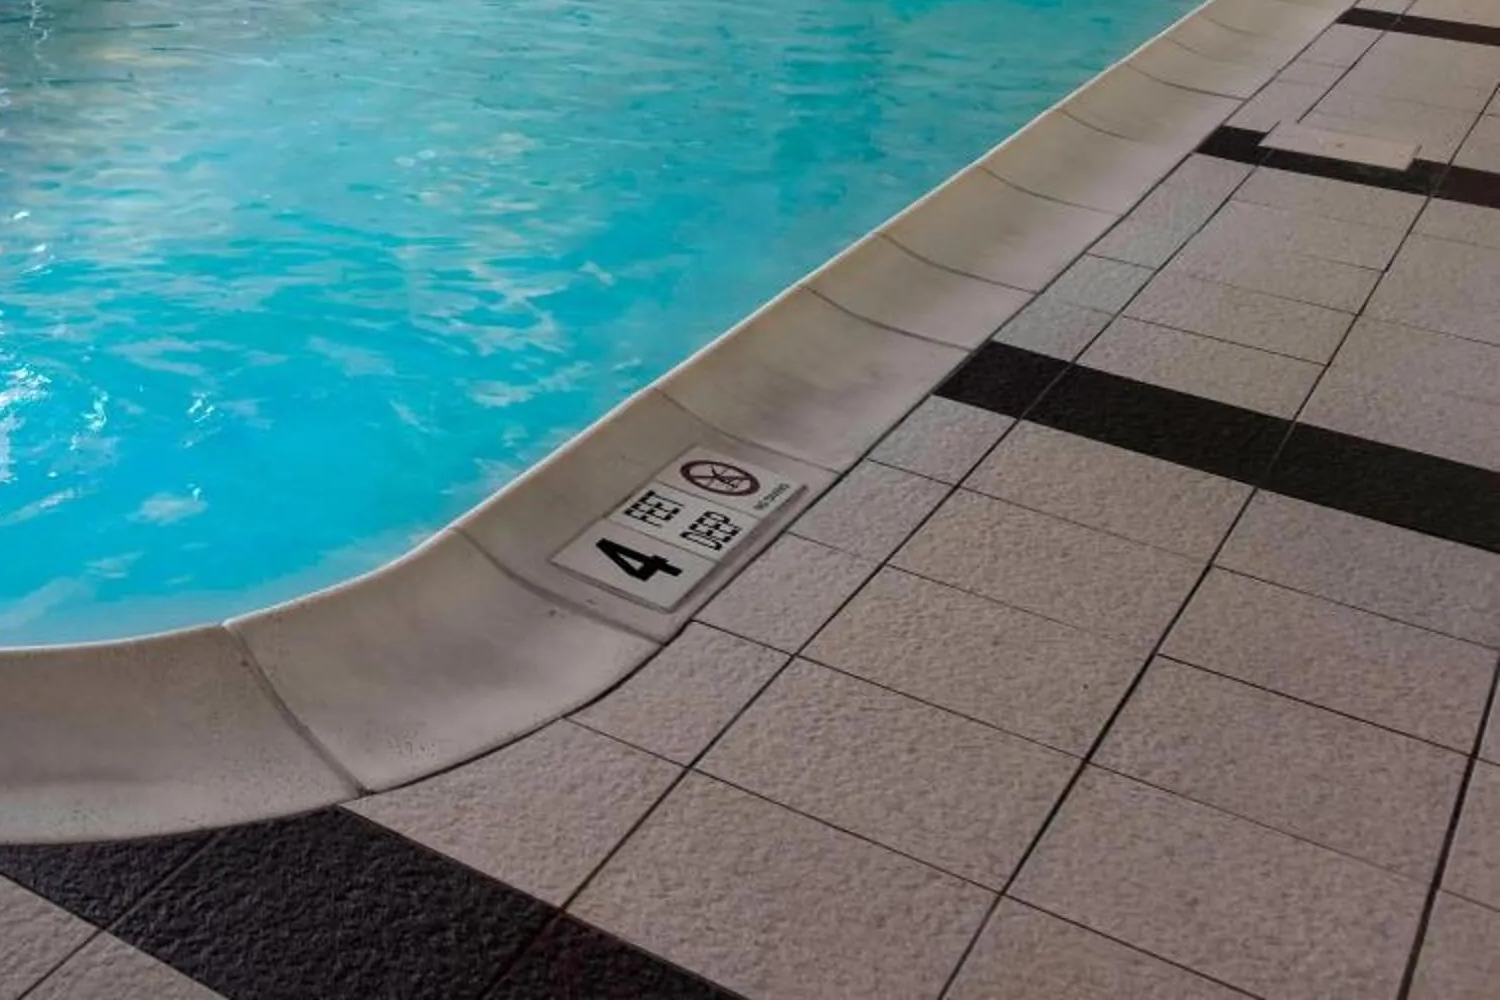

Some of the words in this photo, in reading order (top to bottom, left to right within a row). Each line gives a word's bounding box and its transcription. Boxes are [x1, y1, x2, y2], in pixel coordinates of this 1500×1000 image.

[622, 489, 685, 528] FEET
[679, 510, 743, 551] DEEP
[596, 537, 684, 582] 4
